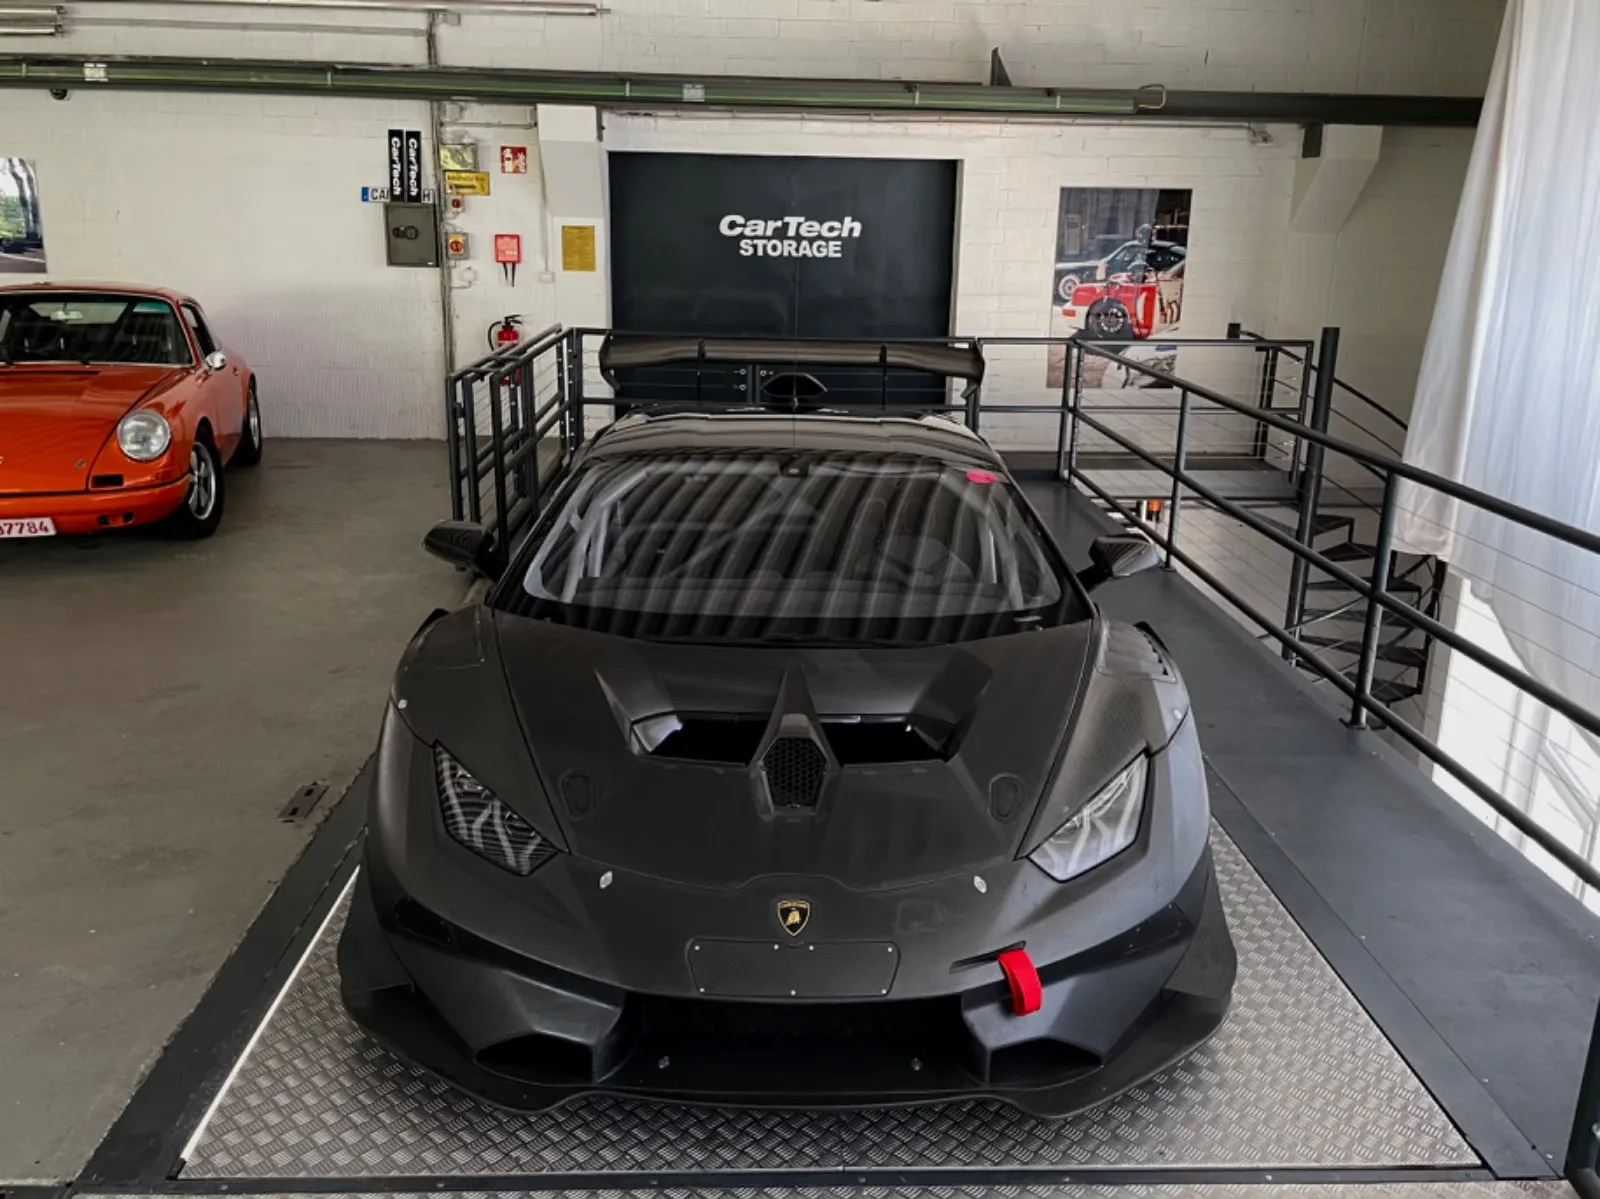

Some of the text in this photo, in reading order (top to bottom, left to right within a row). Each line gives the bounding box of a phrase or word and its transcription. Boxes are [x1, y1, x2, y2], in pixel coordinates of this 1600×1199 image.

[391, 137, 402, 196] CarTech
[408, 138, 419, 196] CarTech
[719, 214, 862, 237] CarTech
[738, 239, 842, 258] STORAGE
